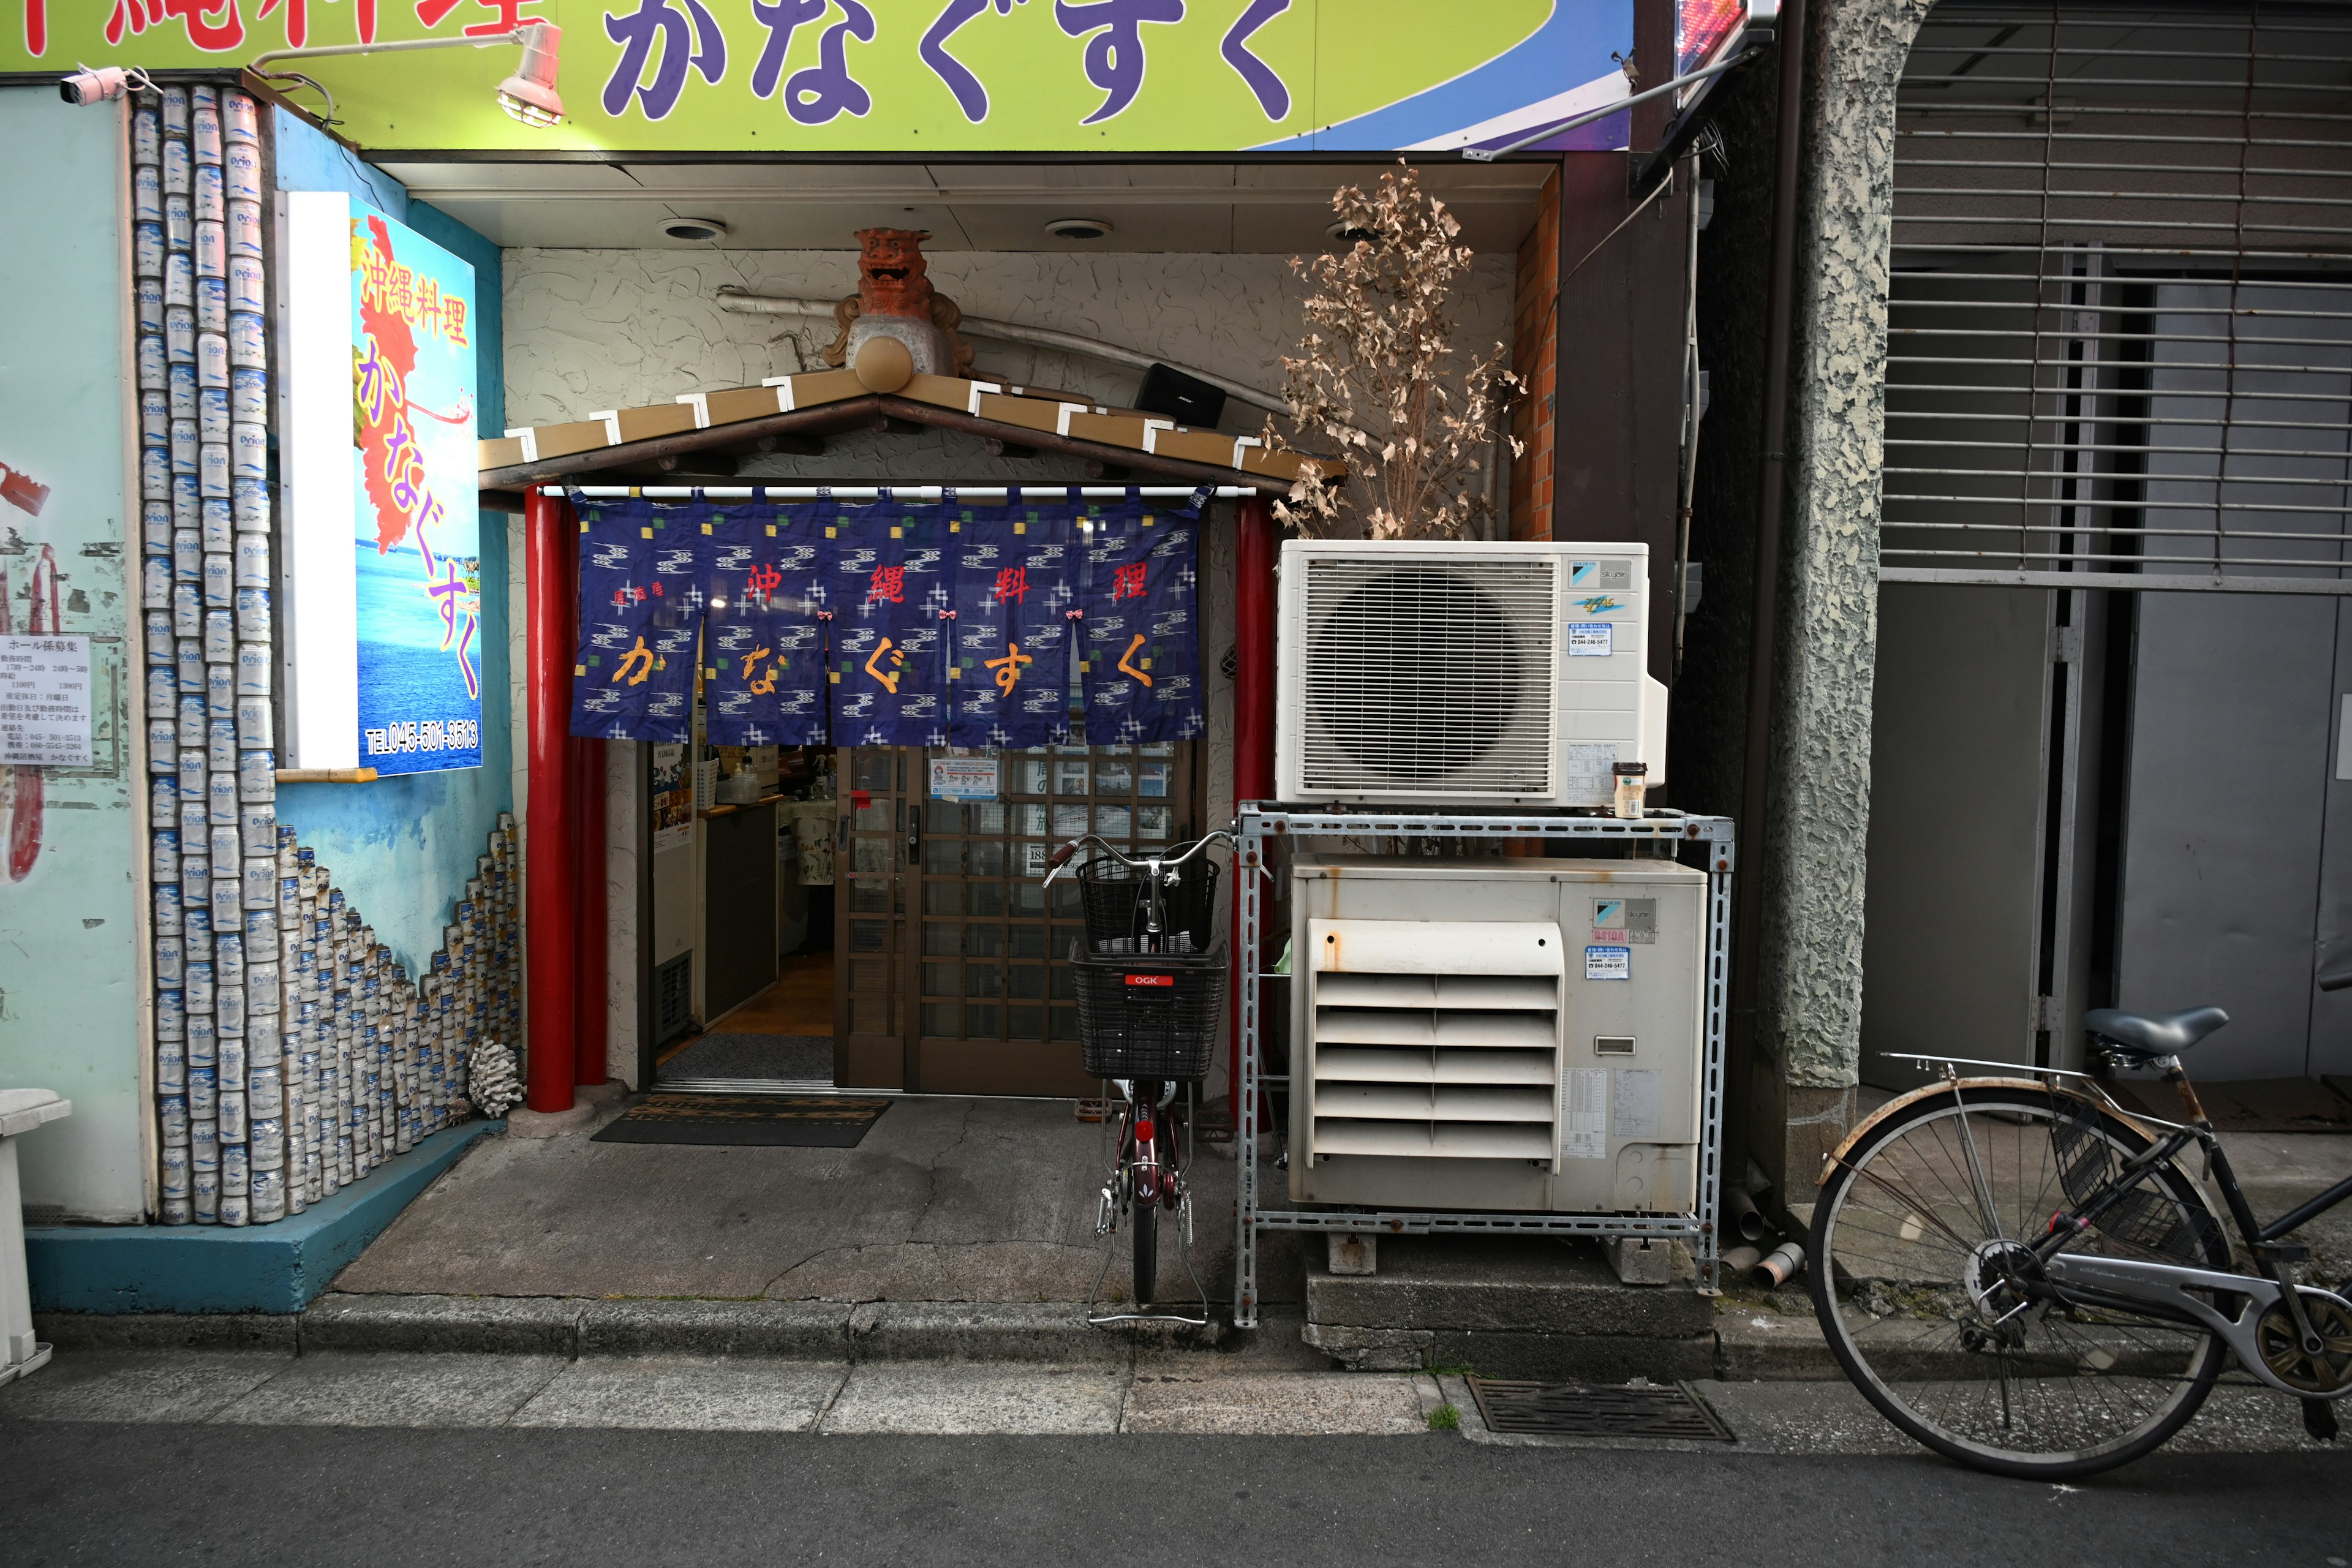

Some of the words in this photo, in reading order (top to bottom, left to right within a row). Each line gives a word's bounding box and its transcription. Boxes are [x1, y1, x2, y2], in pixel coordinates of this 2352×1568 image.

[361, 248, 469, 347] 沖縄料理
[355, 337, 478, 699] かなぐすく
[614, 581, 663, 605] 居酒屋
[747, 562, 1148, 605] 沖縄料理
[9, 640, 77, 652] ホール係募集
[612, 633, 1153, 697] かなぐすく
